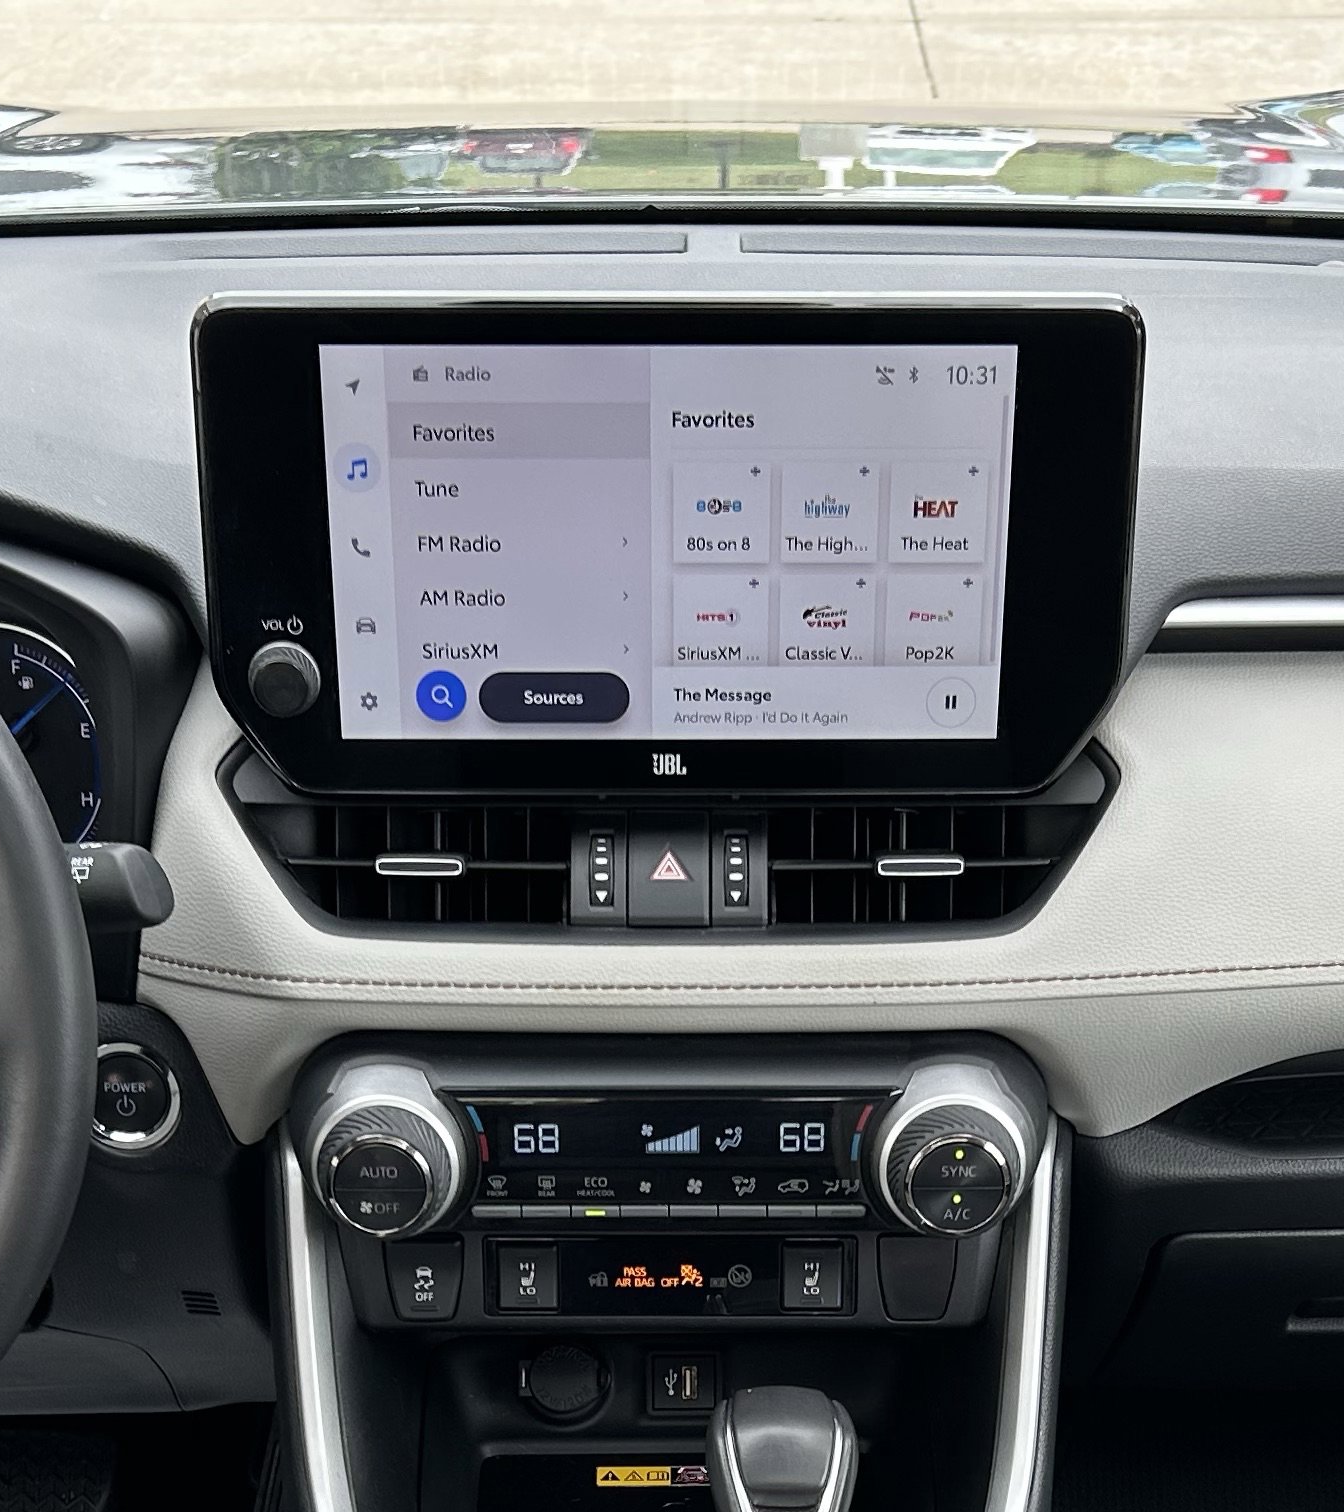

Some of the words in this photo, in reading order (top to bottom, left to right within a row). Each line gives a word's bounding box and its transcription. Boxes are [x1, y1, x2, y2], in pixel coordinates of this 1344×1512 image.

[445, 366, 491, 382] Radio
[945, 365, 998, 386] 10:31
[671, 411, 755, 429] Favorites
[412, 424, 495, 443] Favorites
[414, 480, 459, 498] Tune
[913, 500, 958, 518] HEAT
[417, 536, 445, 552] FM
[449, 535, 502, 553] Radio
[686, 537, 714, 551] 80s
[718, 540, 737, 552] on
[741, 537, 751, 551] 8
[785, 537, 813, 551] The
[901, 537, 929, 551] The
[933, 537, 969, 551] Heat
[419, 590, 449, 606] AM
[454, 589, 506, 607] Radio
[261, 618, 286, 632] VOL
[422, 642, 500, 660] SiriusXM
[677, 646, 742, 661] SiriusXM
[785, 645, 837, 661] Classic
[905, 646, 955, 663] Pop2K
[11, 659, 21, 674] F
[523, 689, 584, 706] Sources
[674, 688, 702, 702] The
[705, 688, 773, 705] Message
[673, 711, 722, 724] Andrew
[725, 711, 753, 727] Ripp
[762, 711, 777, 724] I'd
[780, 711, 798, 724] Do
[801, 710, 810, 724] It
[813, 710, 849, 727] Again
[80, 723, 90, 738] E
[653, 754, 687, 776] JBL
[80, 791, 94, 807] H
[103, 1081, 146, 1093] POWER
[513, 1122, 560, 1154] 68
[779, 1122, 826, 1153] 68
[359, 1166, 399, 1180] AUTO
[940, 1165, 978, 1179] SYNC
[583, 1176, 608, 1188] ECO
[374, 1202, 401, 1214] OFF
[943, 1208, 972, 1221] A/C
[519, 1262, 536, 1271] HI
[623, 1266, 647, 1277] PASS
[804, 1262, 820, 1271] HI
[615, 1277, 632, 1287] AIR
[634, 1277, 655, 1287] BAG
[660, 1277, 680, 1288] OFF
[414, 1292, 434, 1302] OFF
[519, 1286, 536, 1296] LO
[803, 1286, 820, 1296] LO
